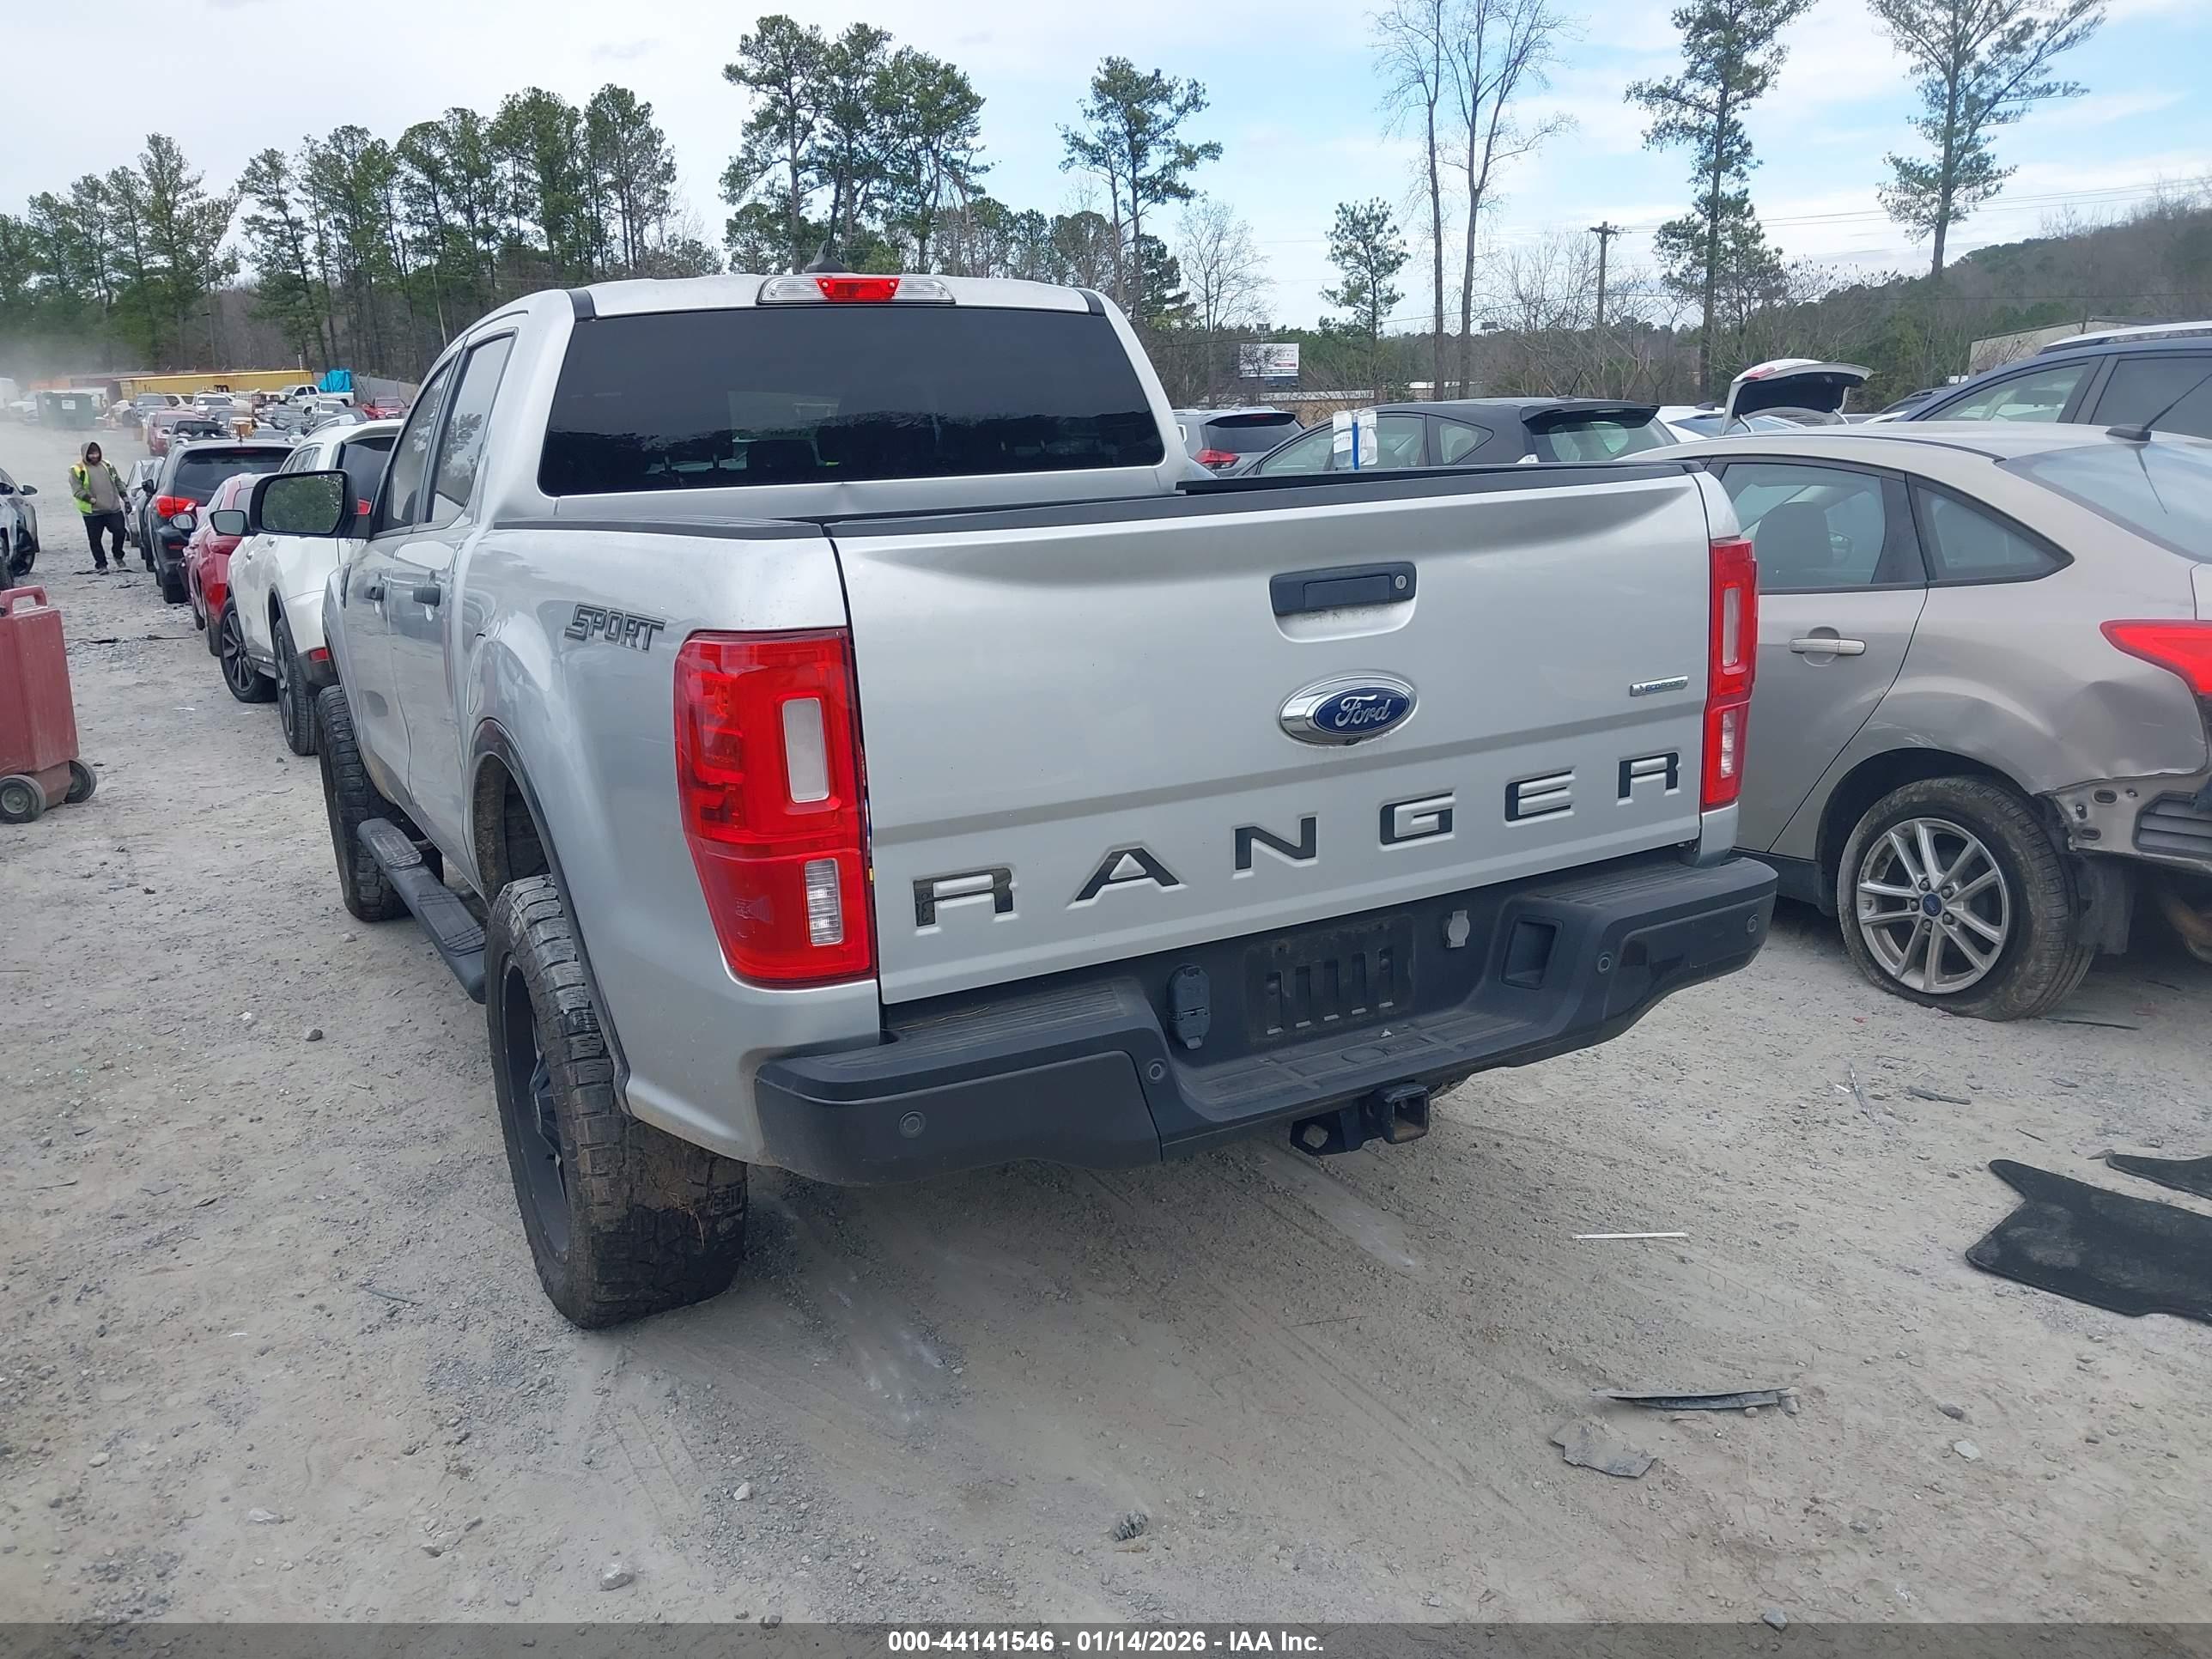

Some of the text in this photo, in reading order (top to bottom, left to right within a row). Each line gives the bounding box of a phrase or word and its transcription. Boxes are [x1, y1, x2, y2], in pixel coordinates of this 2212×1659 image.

[564, 603, 666, 652] SPORT
[1334, 694, 1392, 727] Ford
[913, 750, 1680, 927] RANGER
